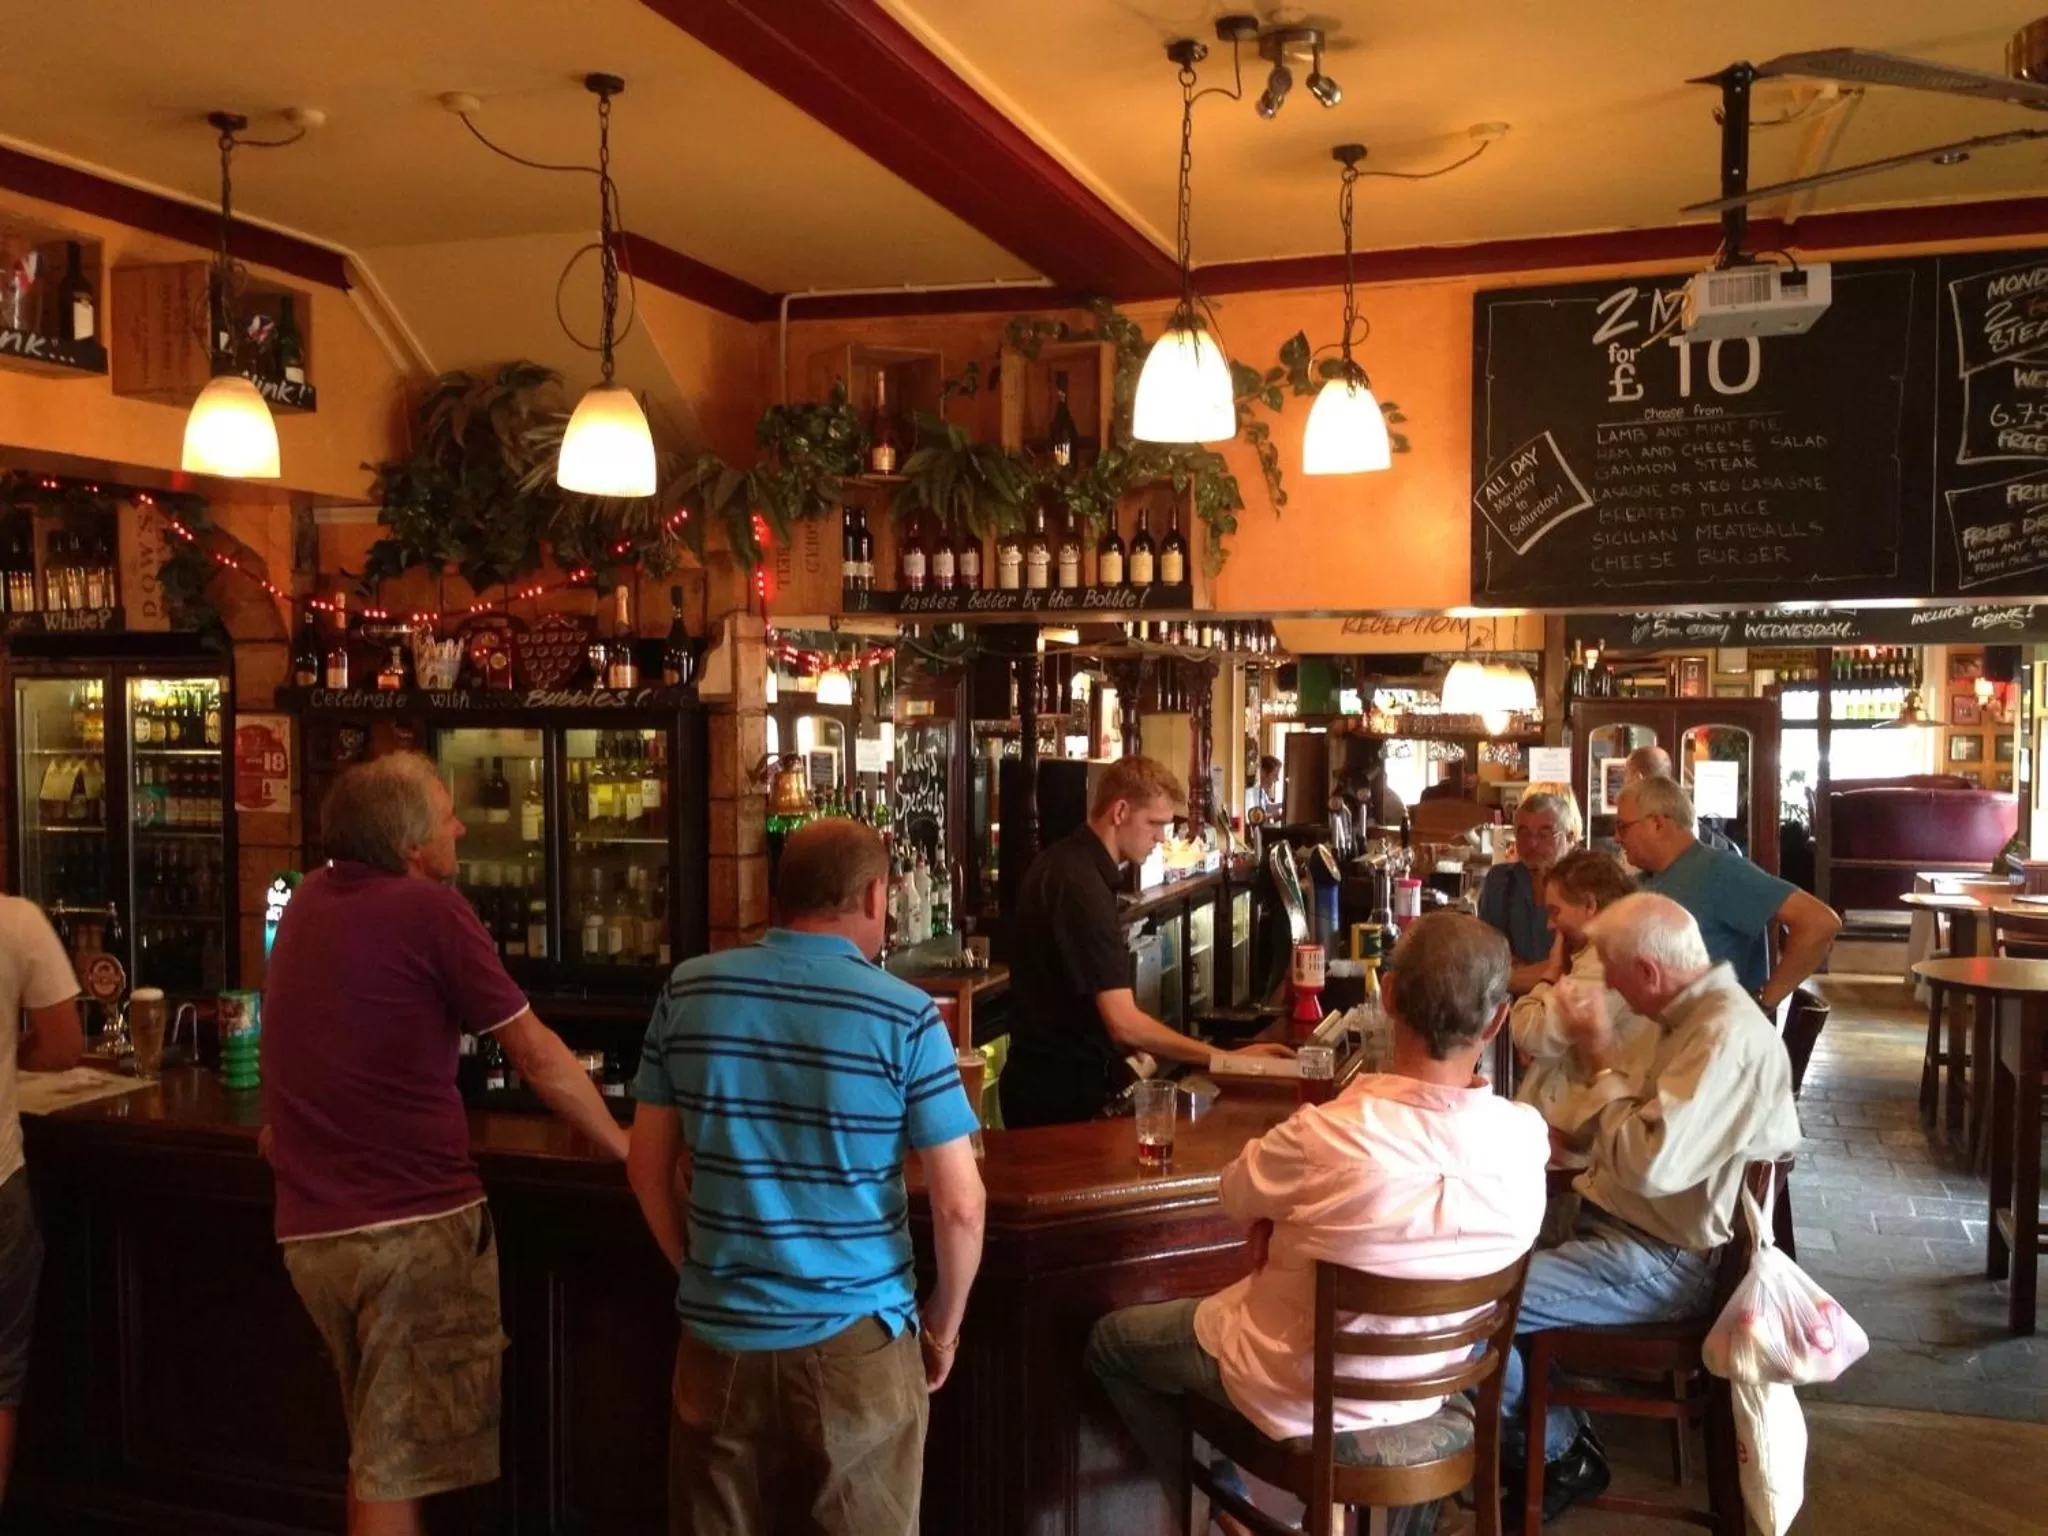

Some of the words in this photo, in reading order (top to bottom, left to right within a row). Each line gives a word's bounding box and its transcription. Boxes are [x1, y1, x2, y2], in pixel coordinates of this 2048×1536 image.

[1592, 286, 1639, 345] 2
[1984, 301, 2021, 333] 2
[1608, 342, 1641, 364] for
[1644, 407, 1684, 420] choose
[1694, 404, 1723, 416] from
[1597, 428, 1647, 444] LAMB
[1656, 426, 1688, 438] AND
[1641, 443, 1672, 457] AND
[1681, 439, 1753, 457] CHEESE
[1770, 435, 1828, 448] SALAD
[1486, 476, 1511, 501] ALL
[1510, 447, 1539, 477] DAY
[1595, 462, 1677, 481] GAMMON
[1695, 457, 1759, 472] STEAK
[1493, 472, 1535, 514] Monday
[1669, 483, 1692, 495] OR
[1516, 500, 1528, 512] to
[1700, 500, 1771, 518] PLAICE
[1592, 528, 1679, 549] SICILIAN
[1695, 520, 1824, 541] MEATBALLS
[1591, 552, 1676, 572] CHEESE
[1697, 546, 1792, 565] BURGER
[968, 590, 1017, 609] better
[1023, 591, 1042, 612] by
[1048, 590, 1075, 608] the
[43, 609, 112, 631] White?
[1341, 616, 1469, 636] RECEPTION
[310, 688, 409, 709] Celebrate
[430, 690, 472, 710] with
[264, 751, 285, 772] 18
